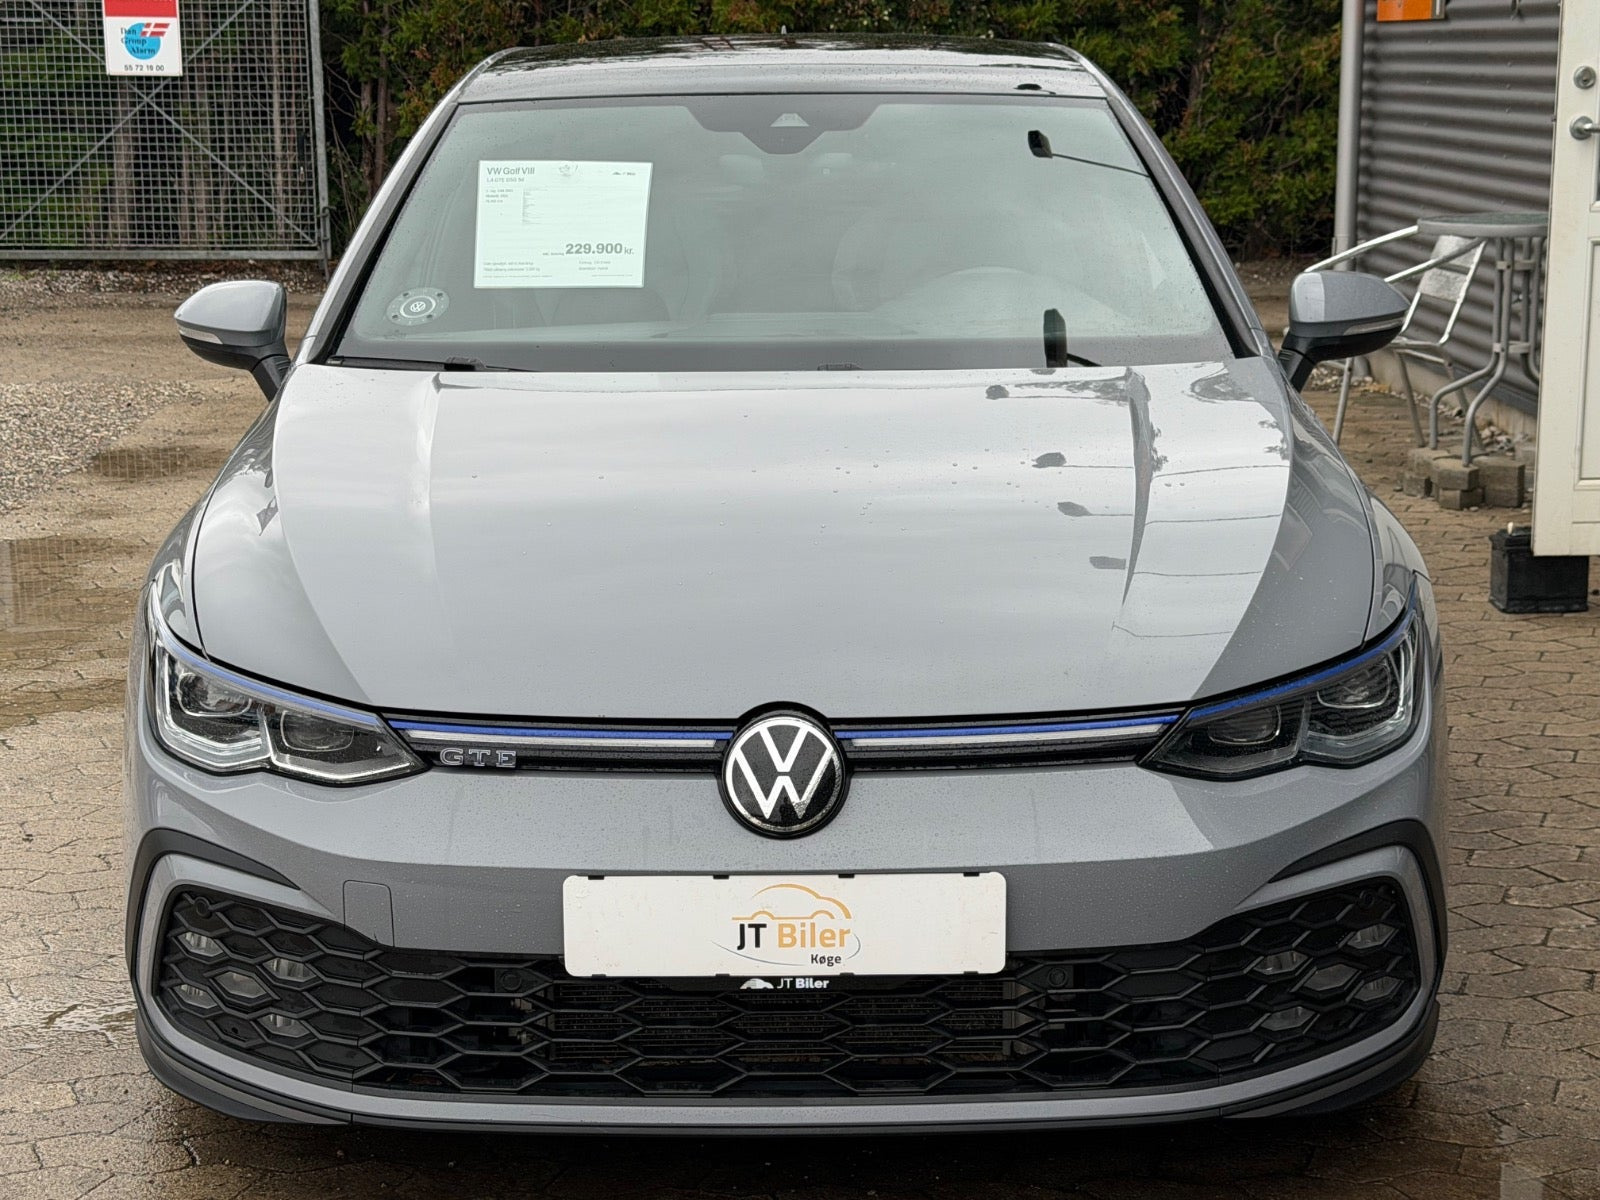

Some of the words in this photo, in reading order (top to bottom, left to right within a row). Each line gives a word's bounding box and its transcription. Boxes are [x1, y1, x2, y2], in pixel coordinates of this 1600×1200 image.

[120, 38, 147, 46] Group
[131, 46, 156, 55] Alarm
[486, 167, 502, 175] VW
[503, 167, 520, 175] Golf
[521, 167, 535, 175] VIII
[565, 242, 623, 255] 229.900
[624, 246, 635, 255] kr.
[439, 747, 517, 768] GTE
[736, 923, 767, 951] JT
[777, 922, 851, 948] Biler
[810, 953, 842, 966] Køge
[777, 978, 795, 989] JT
[795, 977, 829, 989] Biler
